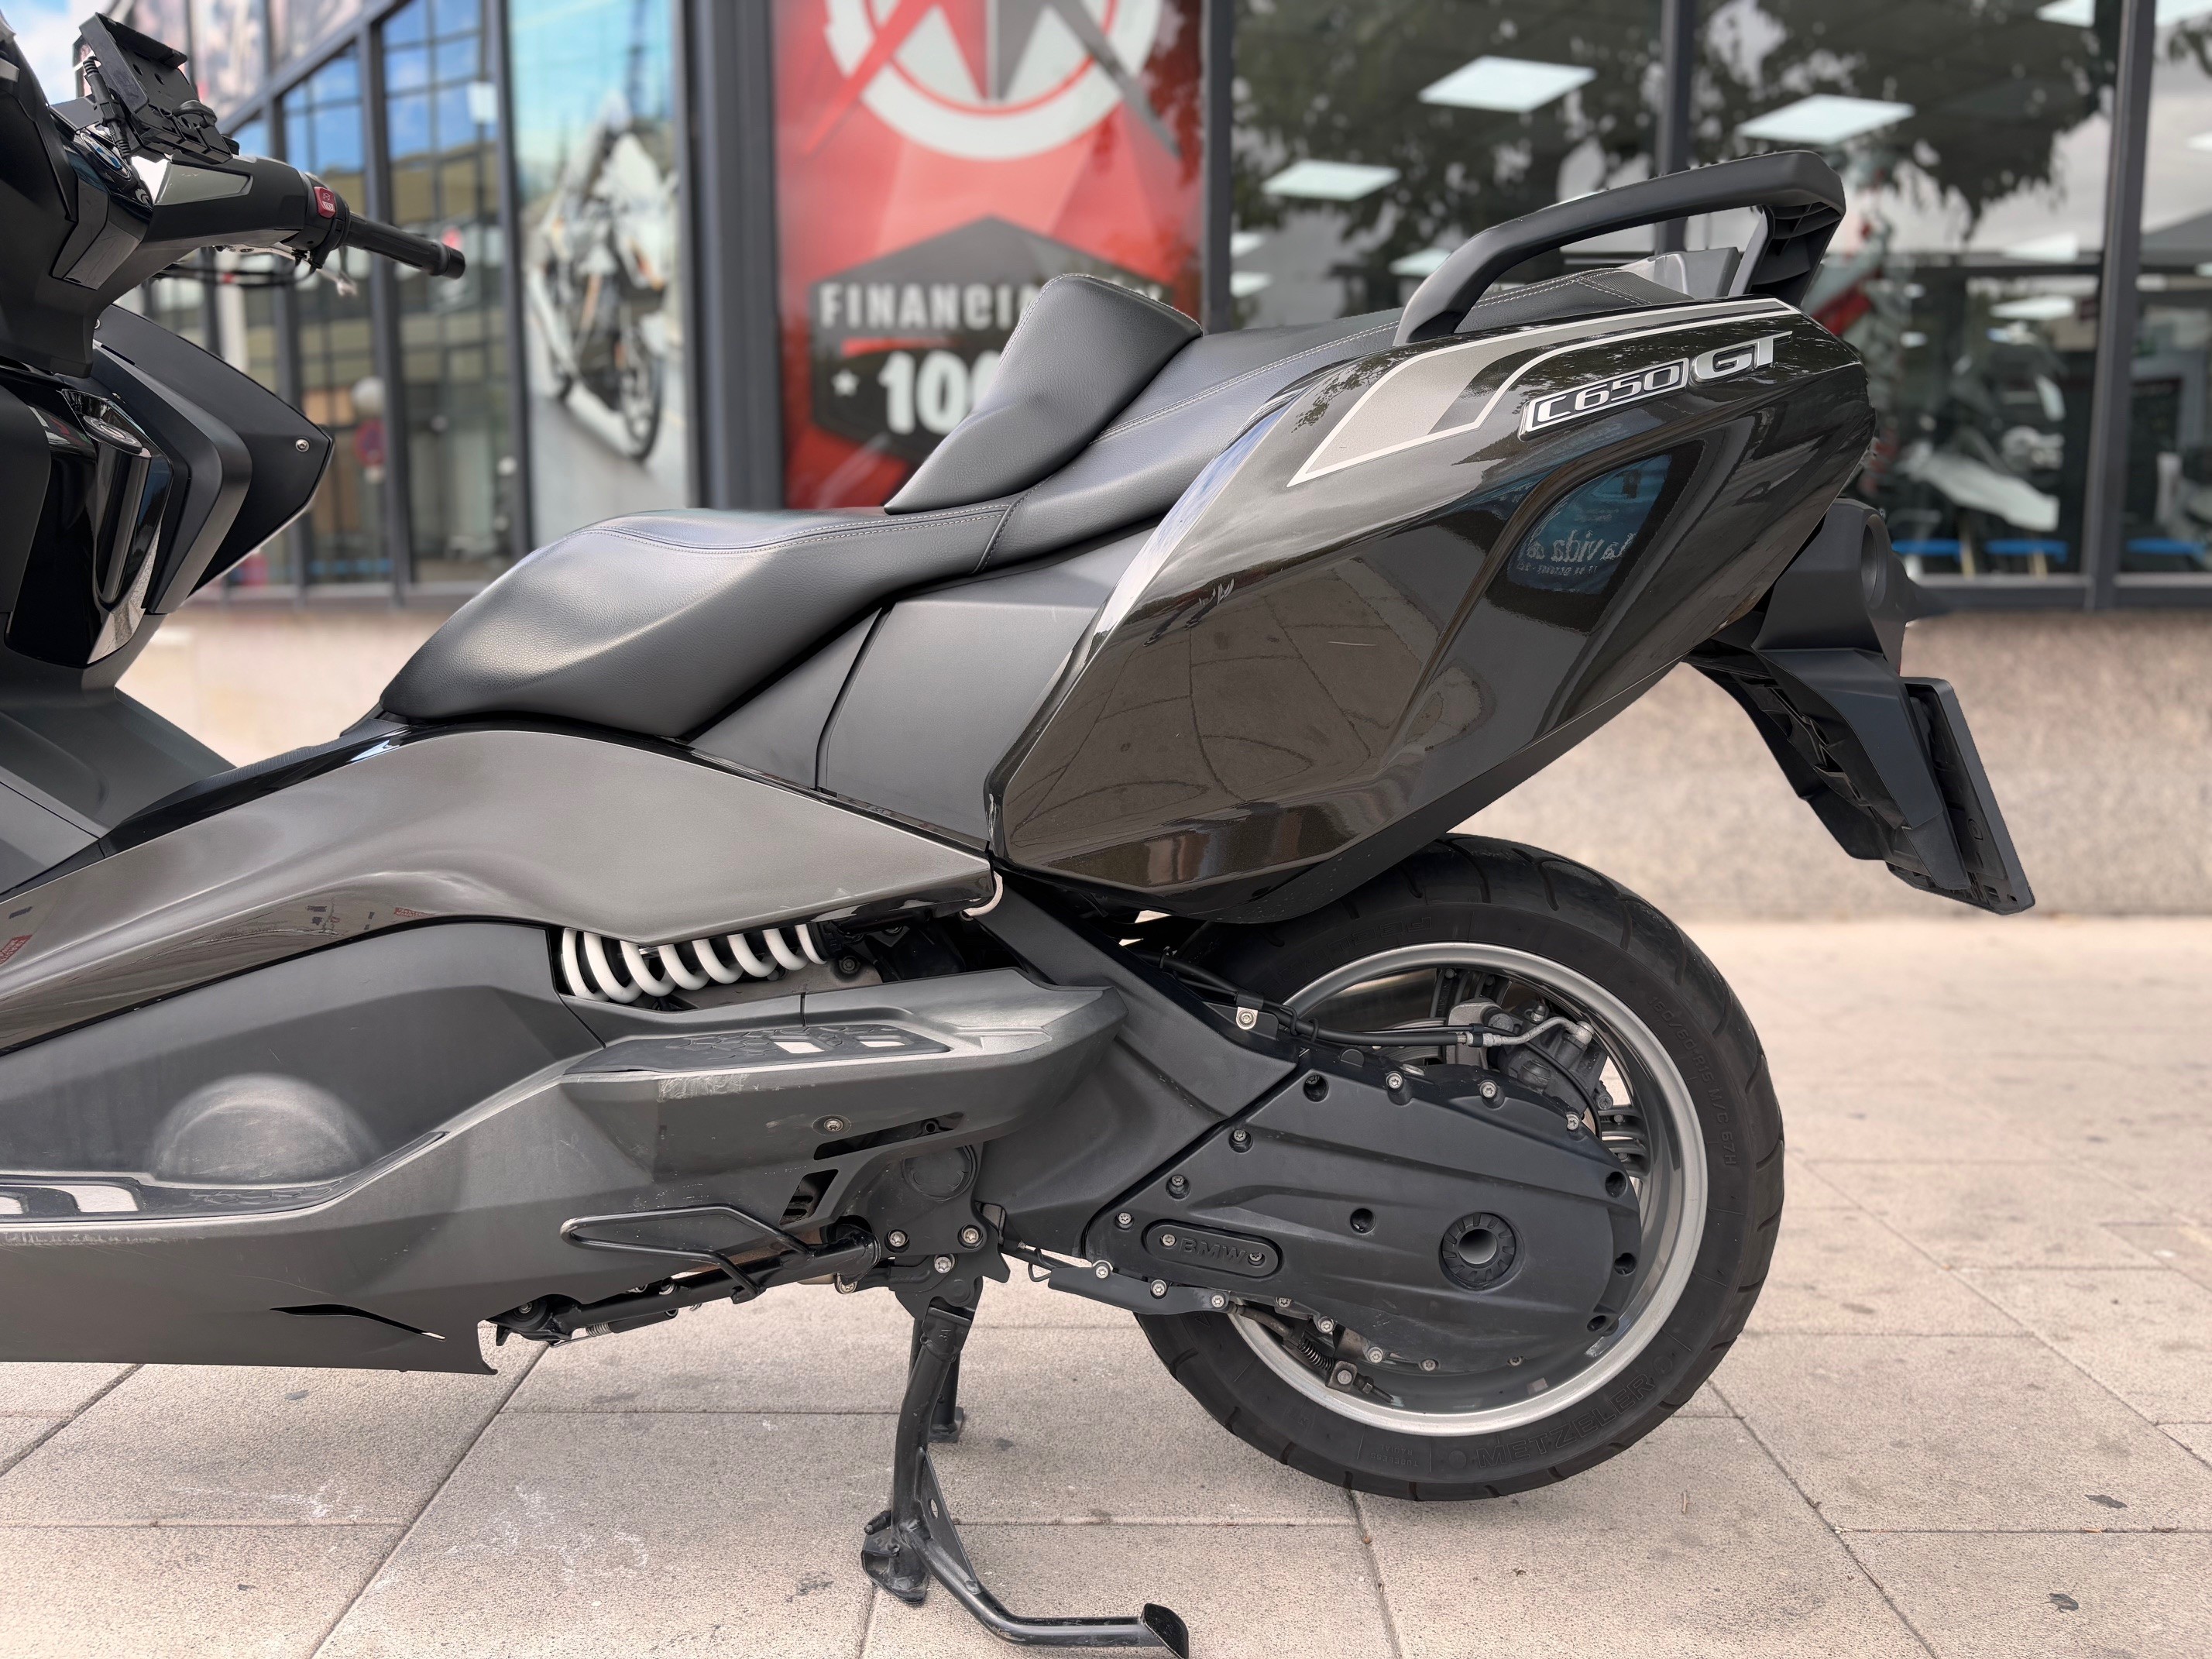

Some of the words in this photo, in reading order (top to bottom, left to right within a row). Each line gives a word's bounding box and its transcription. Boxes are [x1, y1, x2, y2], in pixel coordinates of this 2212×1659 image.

[1691, 331, 1794, 380] GT
[1721, 1131, 1737, 1166] 67H
[1179, 1238, 1245, 1262] BMW
[1475, 1373, 1656, 1468] METZELER
